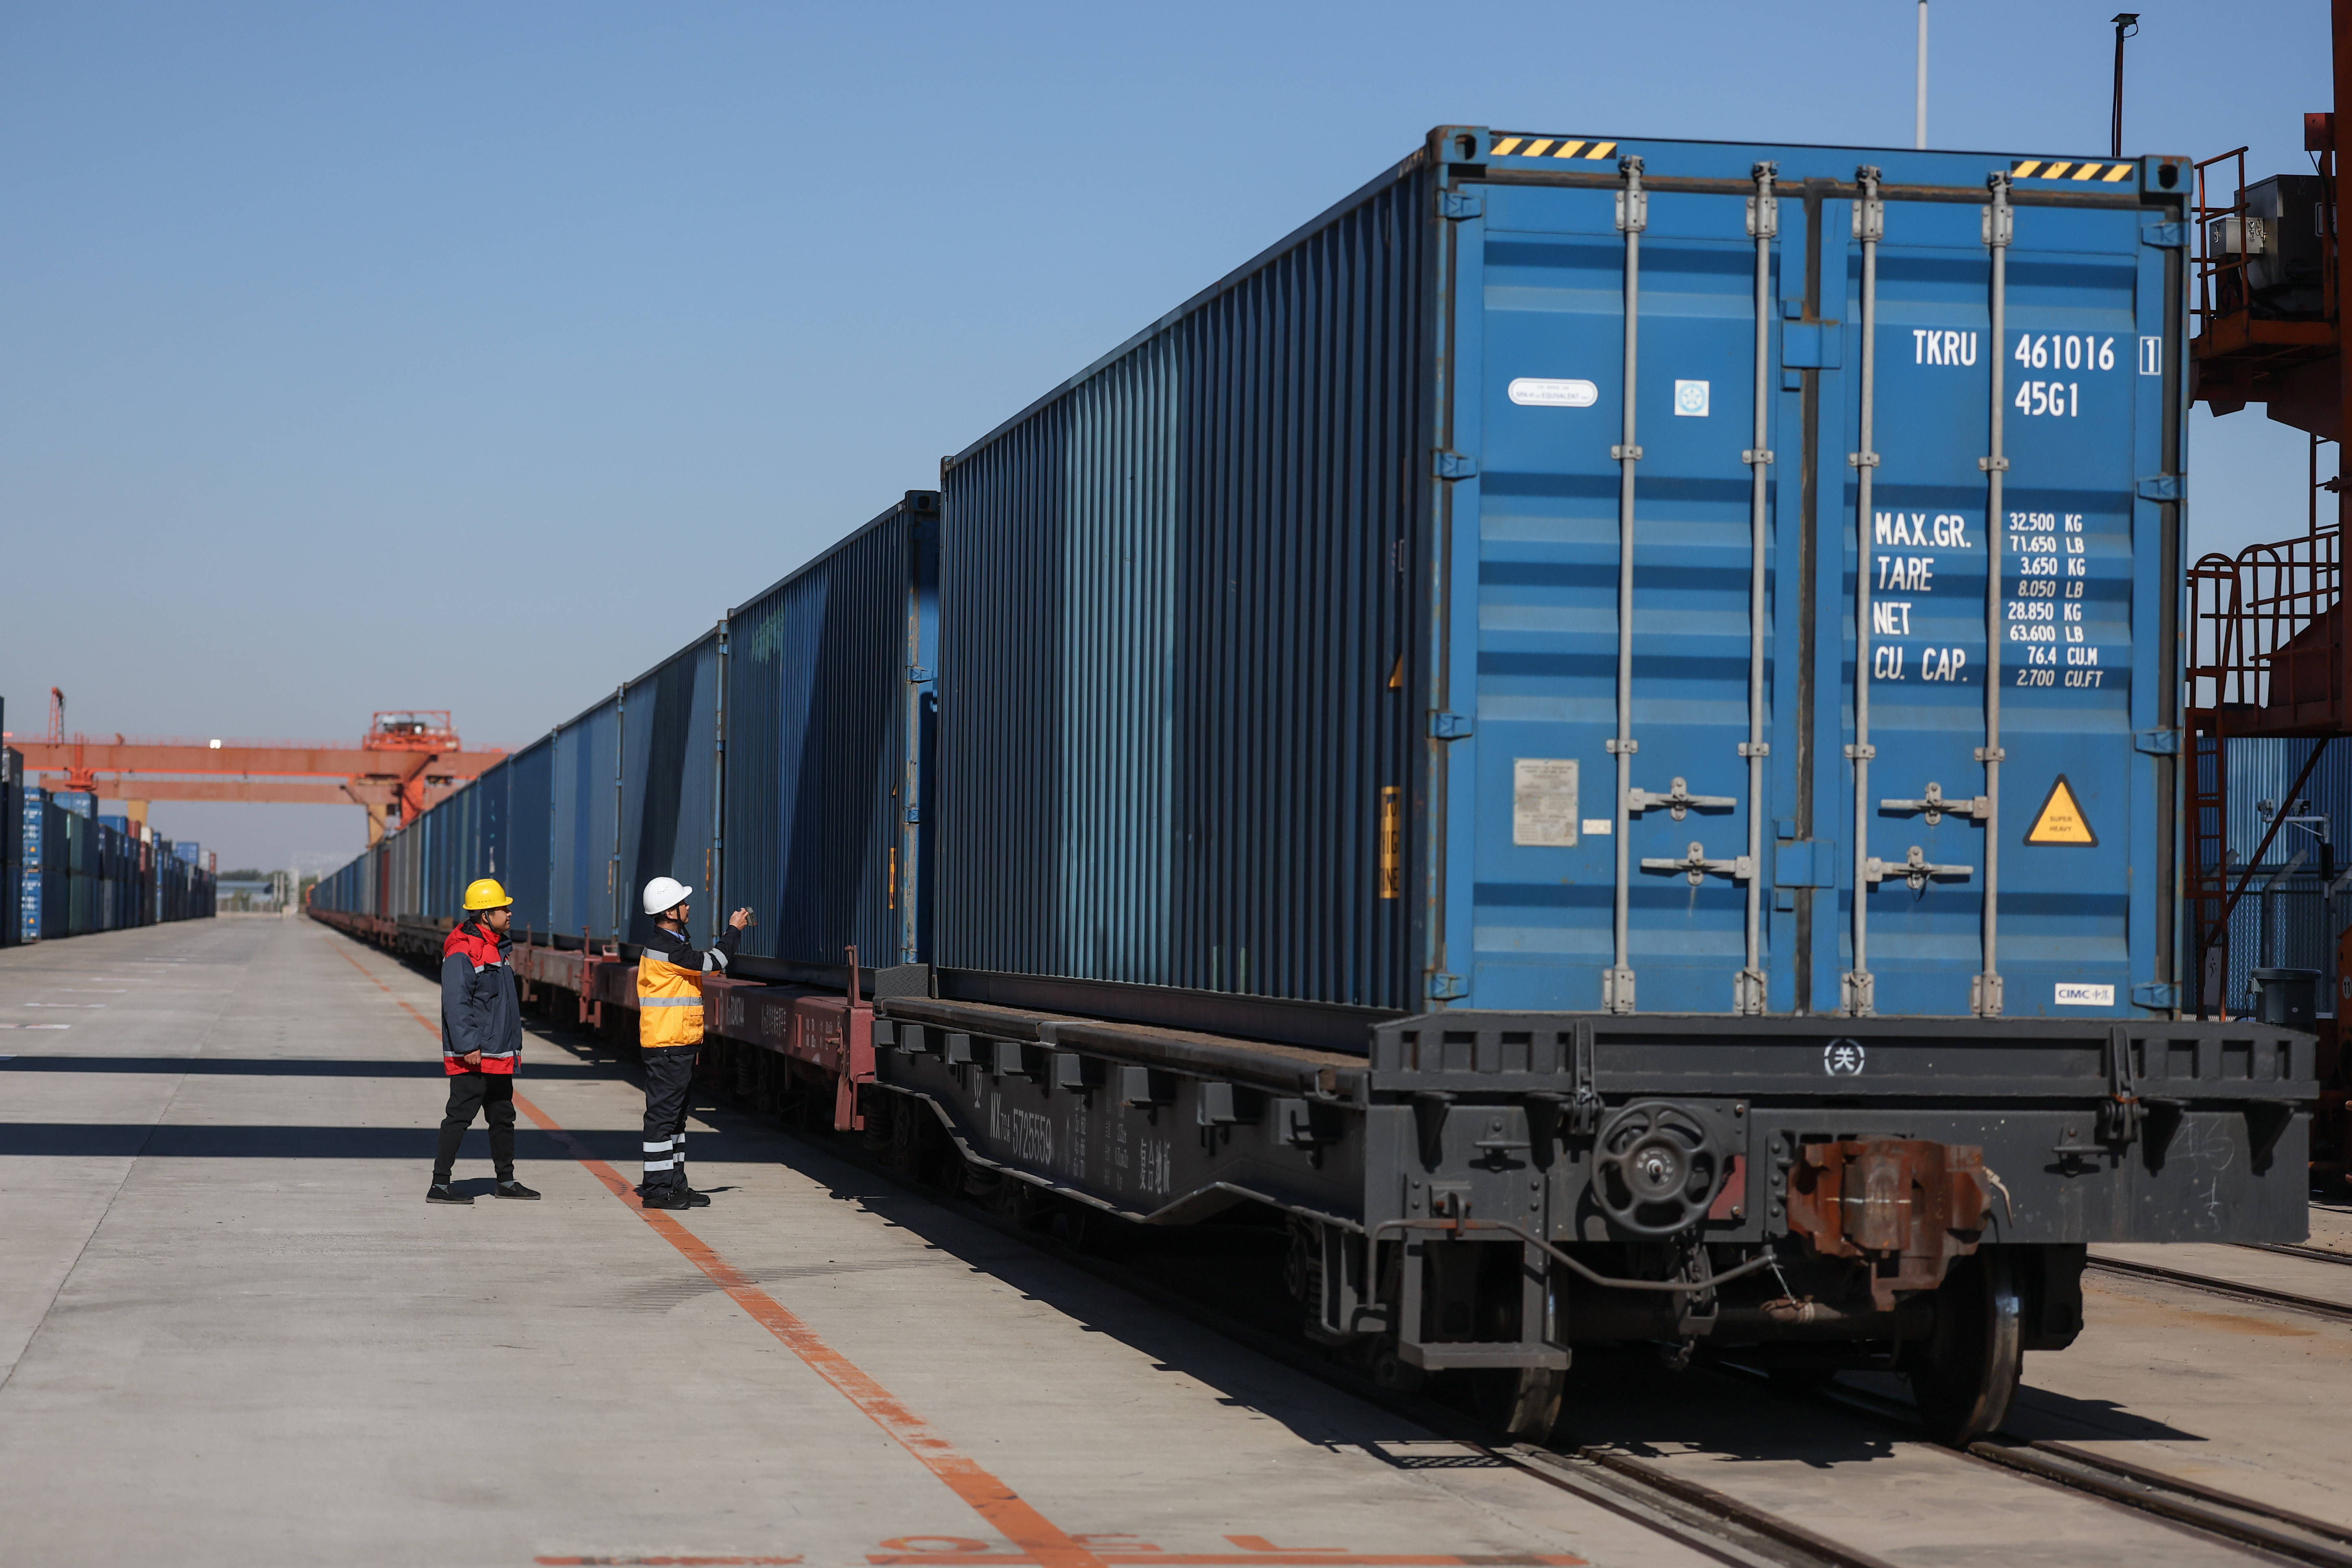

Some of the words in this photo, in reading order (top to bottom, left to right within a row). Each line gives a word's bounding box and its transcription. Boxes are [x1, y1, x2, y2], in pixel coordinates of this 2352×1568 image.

[1913, 330, 1976, 366] TKRU
[2015, 334, 2114, 370] 461016
[2015, 381, 2078, 417] 45G1
[1876, 512, 1971, 548] MAX.GR.
[2009, 513, 2055, 531] 32.500
[2065, 514, 2082, 532] KG
[2010, 535, 2056, 552] 71.650
[2066, 537, 2084, 553] LB
[1878, 556, 1934, 591] TARE
[2021, 557, 2058, 575] 3.650
[2068, 558, 2085, 576] KG
[2018, 580, 2056, 597] 8.050
[2065, 581, 2084, 598] LB
[1873, 602, 1911, 635] NET
[2008, 602, 2054, 620] 28.850
[2064, 603, 2081, 621] KG
[2010, 625, 2056, 642] 63.600
[2065, 626, 2084, 642] LB
[1875, 646, 1904, 679] CU.
[1922, 648, 1967, 681] CAP.
[2027, 646, 2056, 665] 76.4
[2067, 647, 2097, 665] CU.M
[2017, 669, 2055, 686] 2.700
[2065, 670, 2104, 687] CU.FT
[2058, 989, 2090, 999] CIMC
[2343, 981, 2350, 994] 11
[1013, 1108, 1052, 1165] 5725559
